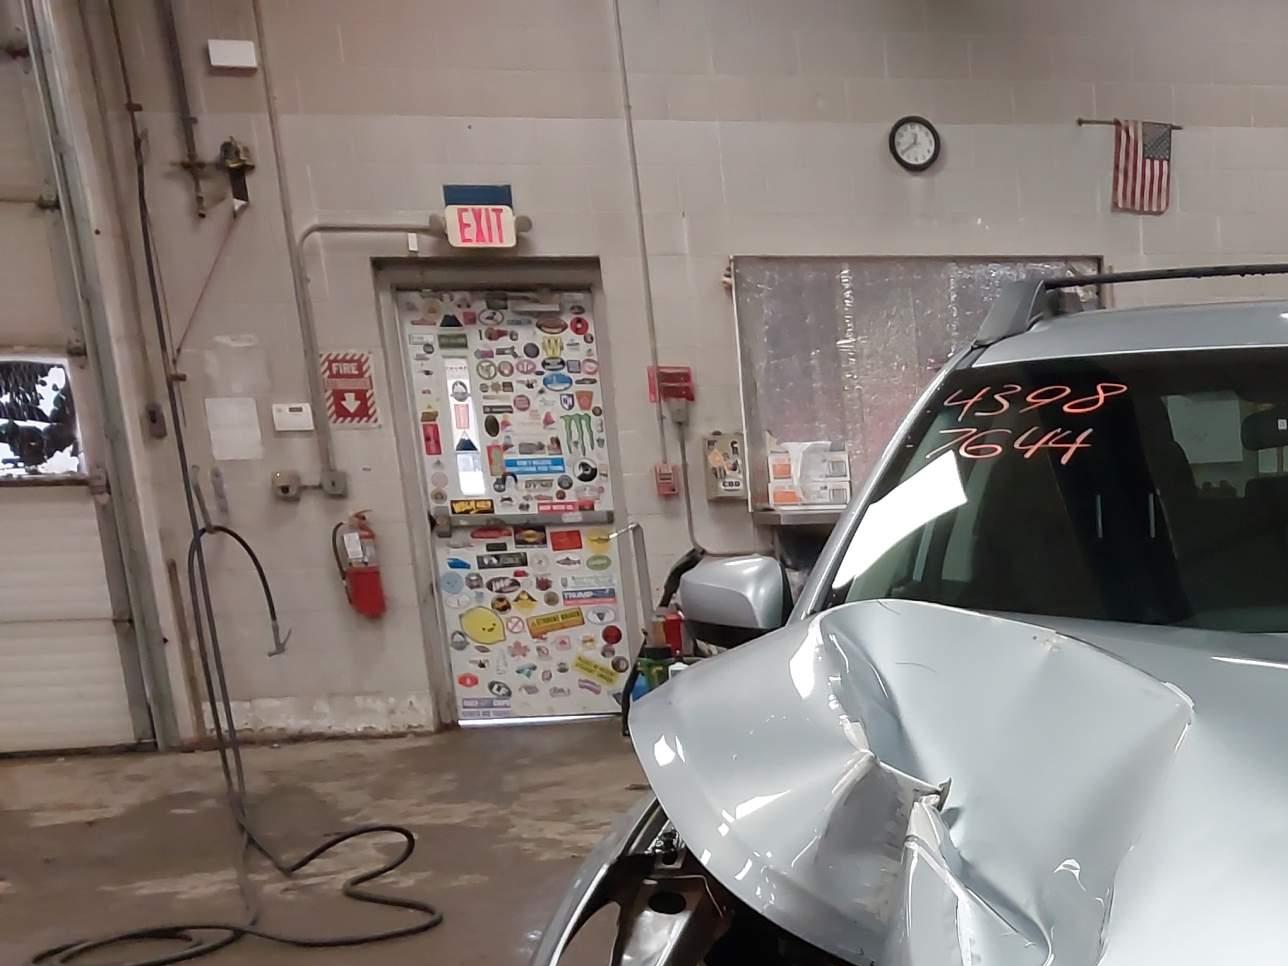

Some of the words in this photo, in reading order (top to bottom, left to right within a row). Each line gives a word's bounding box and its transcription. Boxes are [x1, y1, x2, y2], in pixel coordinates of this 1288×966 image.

[457, 207, 504, 243] EXIT
[331, 362, 359, 375] FIRE
[944, 382, 1128, 422] 4398
[925, 426, 1094, 465] 7644
